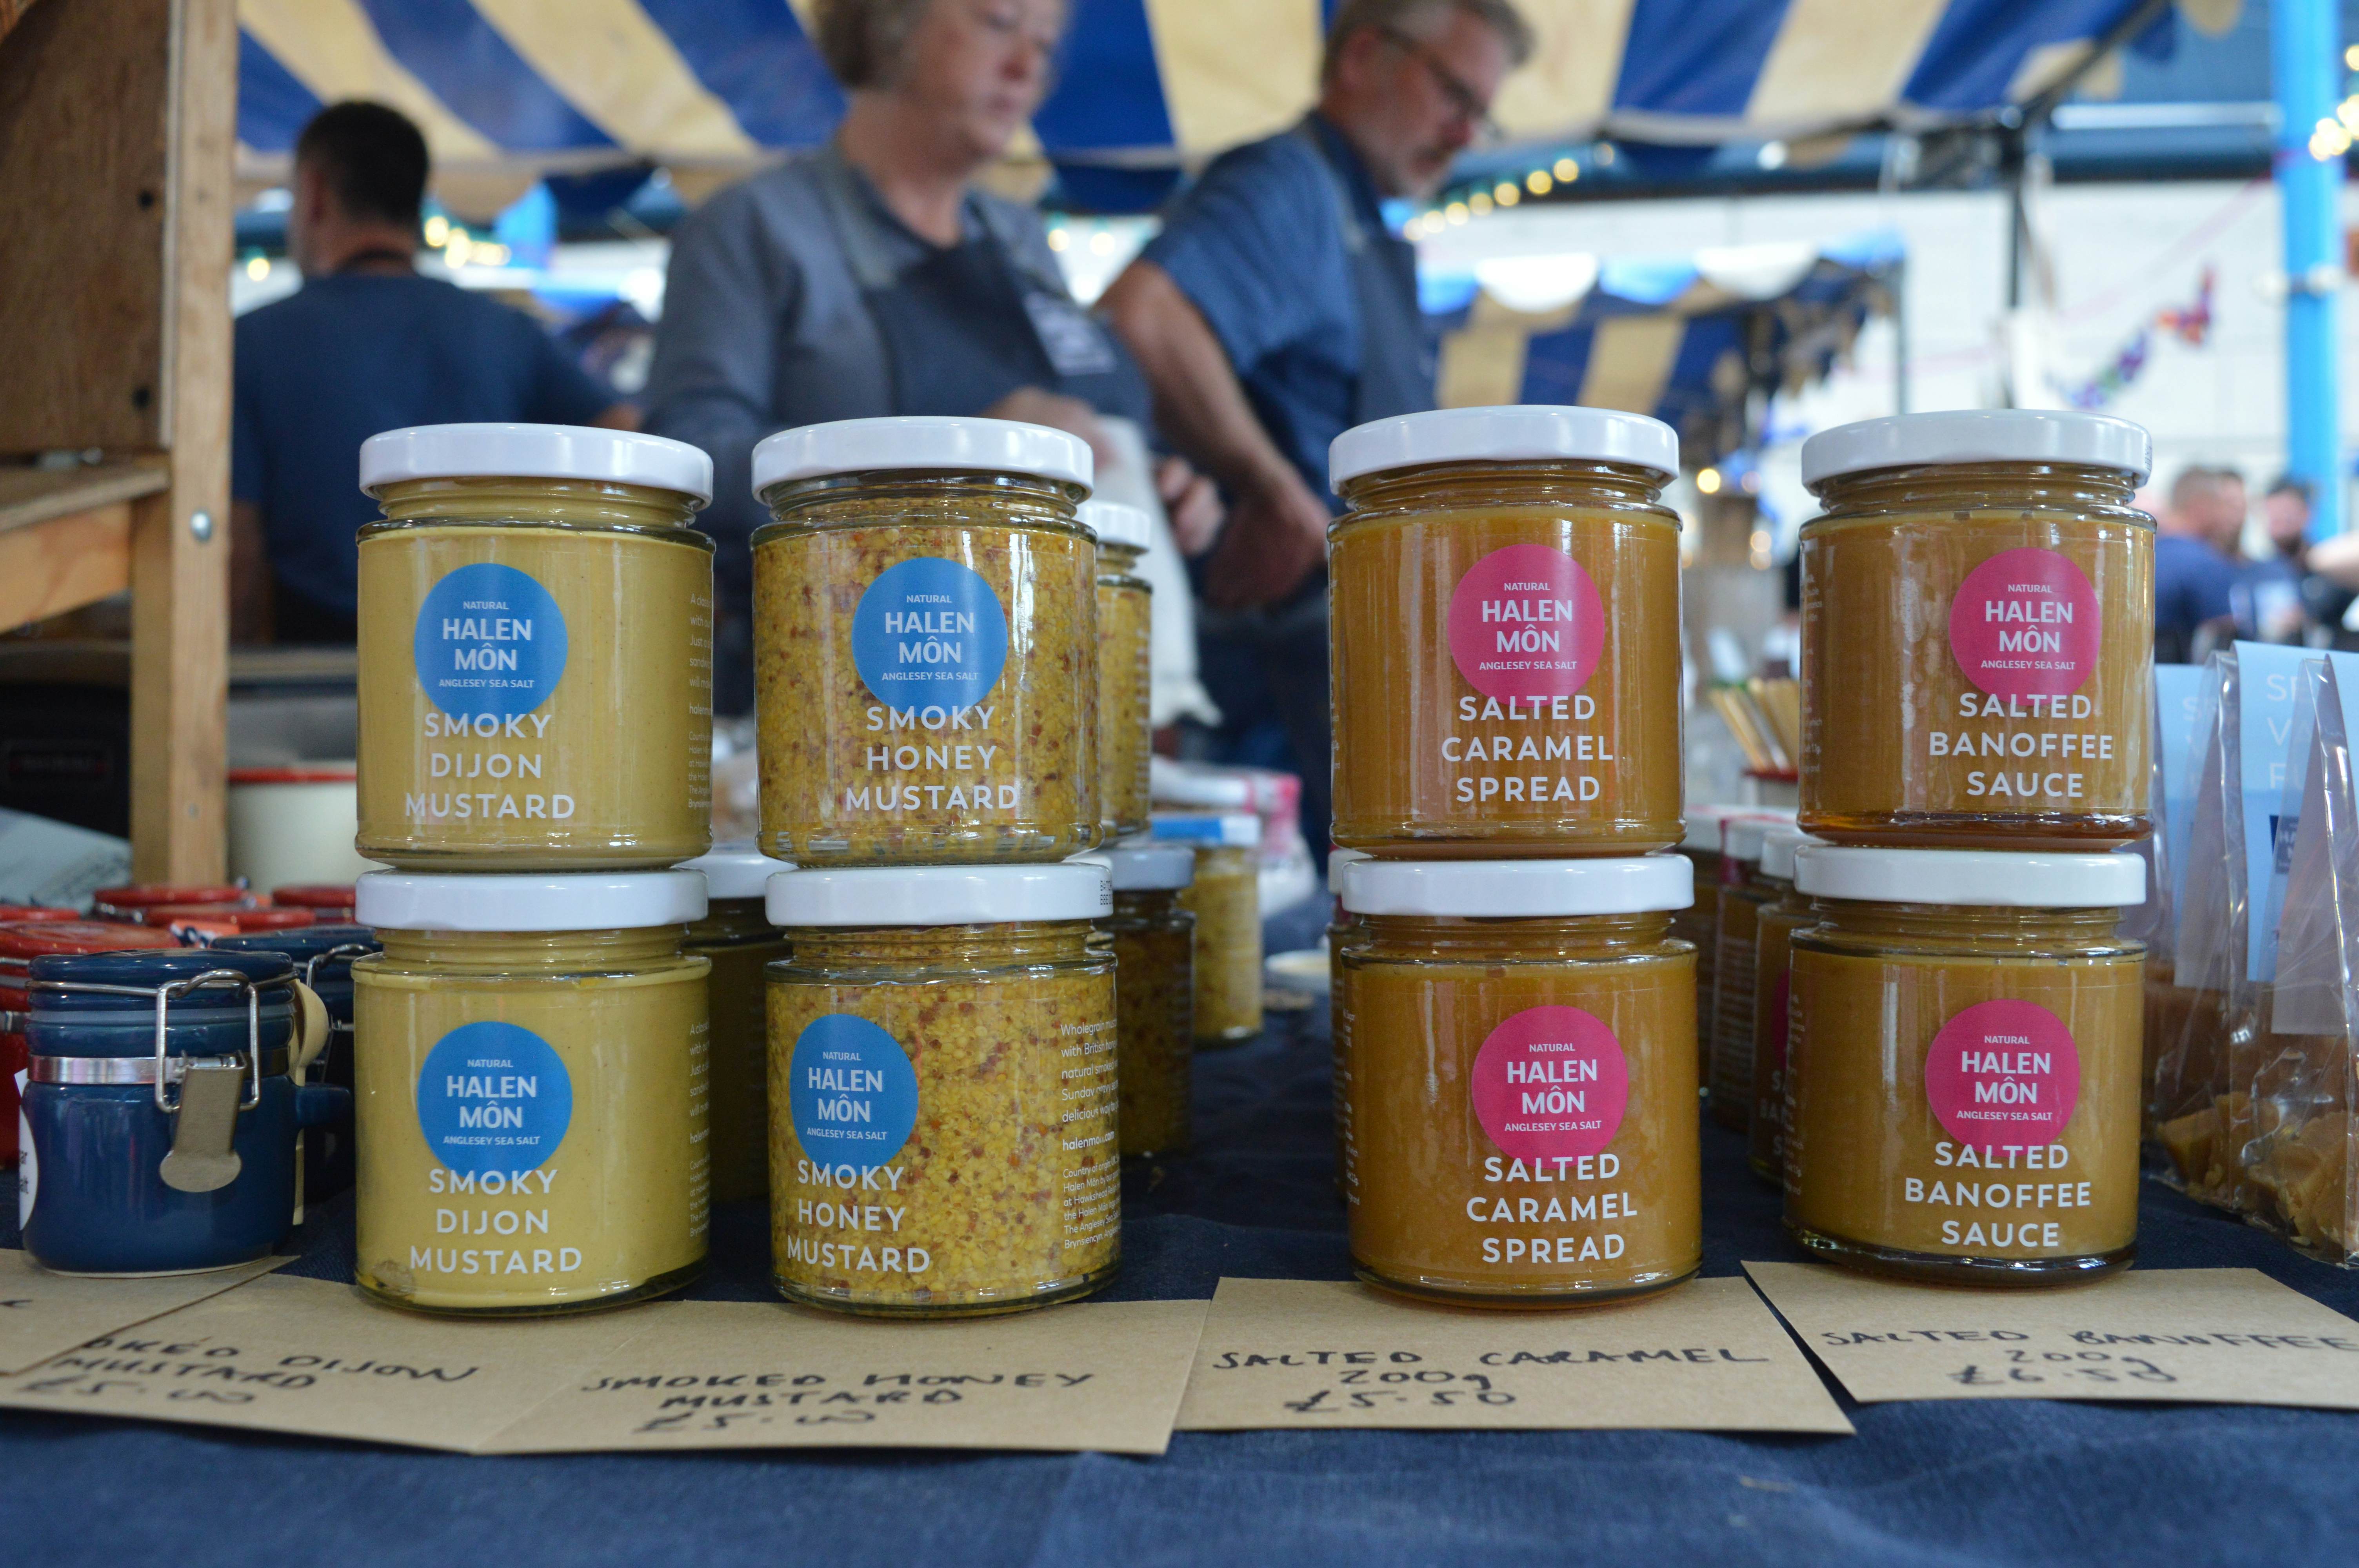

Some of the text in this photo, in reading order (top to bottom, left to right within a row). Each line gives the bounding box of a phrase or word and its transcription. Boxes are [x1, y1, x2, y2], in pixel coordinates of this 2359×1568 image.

[1504, 582, 1550, 591] NATURAL
[2008, 584, 2052, 593] NATURAL
[463, 601, 509, 610] NATURAL
[1482, 599, 1573, 622] HALEN
[1985, 600, 2073, 623] HALEN
[442, 618, 532, 640] HALEN
[885, 612, 974, 633] HALEN
[899, 636, 961, 663] MÔN
[1496, 624, 1560, 653] MÔN
[1999, 624, 2061, 653] MÔN
[454, 643, 516, 671] MÔN
[1479, 661, 1577, 670] ANGLESEY SEA SALT
[1980, 660, 2075, 670] ANGLESEY SEA SALT
[439, 679, 534, 688] ANGLESEY SEA SALT
[881, 672, 978, 681] ANGLESEY SEA SALT
[1459, 695, 1595, 721] SALTED
[1959, 692, 2091, 719] SALTED
[424, 713, 552, 738] SMOKY
[866, 705, 995, 731] SMOKY
[1441, 735, 1613, 762] CARAMEL
[1929, 732, 2113, 759] BANOFFEE
[431, 753, 541, 778] DIJON
[867, 745, 997, 771] HONEY
[1456, 776, 1600, 802] SPREAD
[1966, 771, 2083, 798] SAUCE
[405, 793, 574, 818] MUSTARD
[846, 785, 1019, 811] MUSTARD
[1060, 1021, 1105, 1036] Wholegrain
[1984, 1036, 2029, 1044] NATURAL
[823, 1051, 861, 1061] NATURAL
[1061, 1044, 1081, 1057] with
[1084, 1041, 1105, 1054] British
[1529, 1043, 1575, 1053] NATURAL
[467, 1060, 513, 1068] NATURAL
[1061, 1063, 1093, 1079] natural
[1507, 1058, 1597, 1084] HALEN
[1961, 1051, 2050, 1075] HALEN
[447, 1075, 536, 1098] HALEN
[808, 1067, 883, 1092] HALEN
[1975, 1076, 2037, 1104] MÔN
[818, 1094, 870, 1122] MÔN
[1522, 1085, 1585, 1114] MÔN
[460, 1100, 522, 1129] MÔN
[1062, 1108, 1098, 1122] delicious
[1505, 1120, 1602, 1131] ANGLESEY SEA SALT
[1956, 1110, 2052, 1121] ANGLESEY SEA SALT
[443, 1136, 540, 1145] ANGLESEY SEA SALT
[806, 1127, 887, 1140] ANGLESEY SEA SALT
[1485, 1153, 1620, 1181] SALTED
[1934, 1141, 2068, 1169] SALTED
[429, 1169, 558, 1195] SMOKY
[797, 1159, 905, 1191] SMOKY
[1063, 1167, 1090, 1178] Country
[1063, 1181, 1085, 1192] Halen
[1063, 1198, 1072, 1207] at
[1074, 1189, 1108, 1205] Hawkshead
[1905, 1177, 2091, 1209] BANOFFEE
[798, 1198, 906, 1232] HONEY
[1064, 1211, 1076, 1221] the
[1079, 1205, 1097, 1218] Halen
[1466, 1192, 1637, 1223] CARAMEL
[437, 1209, 548, 1235] DIJON
[1063, 1225, 1078, 1235] The
[1080, 1218, 1105, 1232] Anglesey
[1941, 1220, 2059, 1248] SAUCE
[410, 1246, 582, 1275] MUSTARD
[787, 1235, 930, 1273] MUSTARD
[1482, 1234, 1625, 1264] SPREAD
[1821, 1330, 2030, 1345] SALTED
[1212, 1348, 1770, 1368] SALTED CARAMEL
[581, 1373, 1094, 1391] SMOKED HONEY
[1338, 1370, 1492, 1391] 200g
[658, 1388, 963, 1410] MUSTARD
